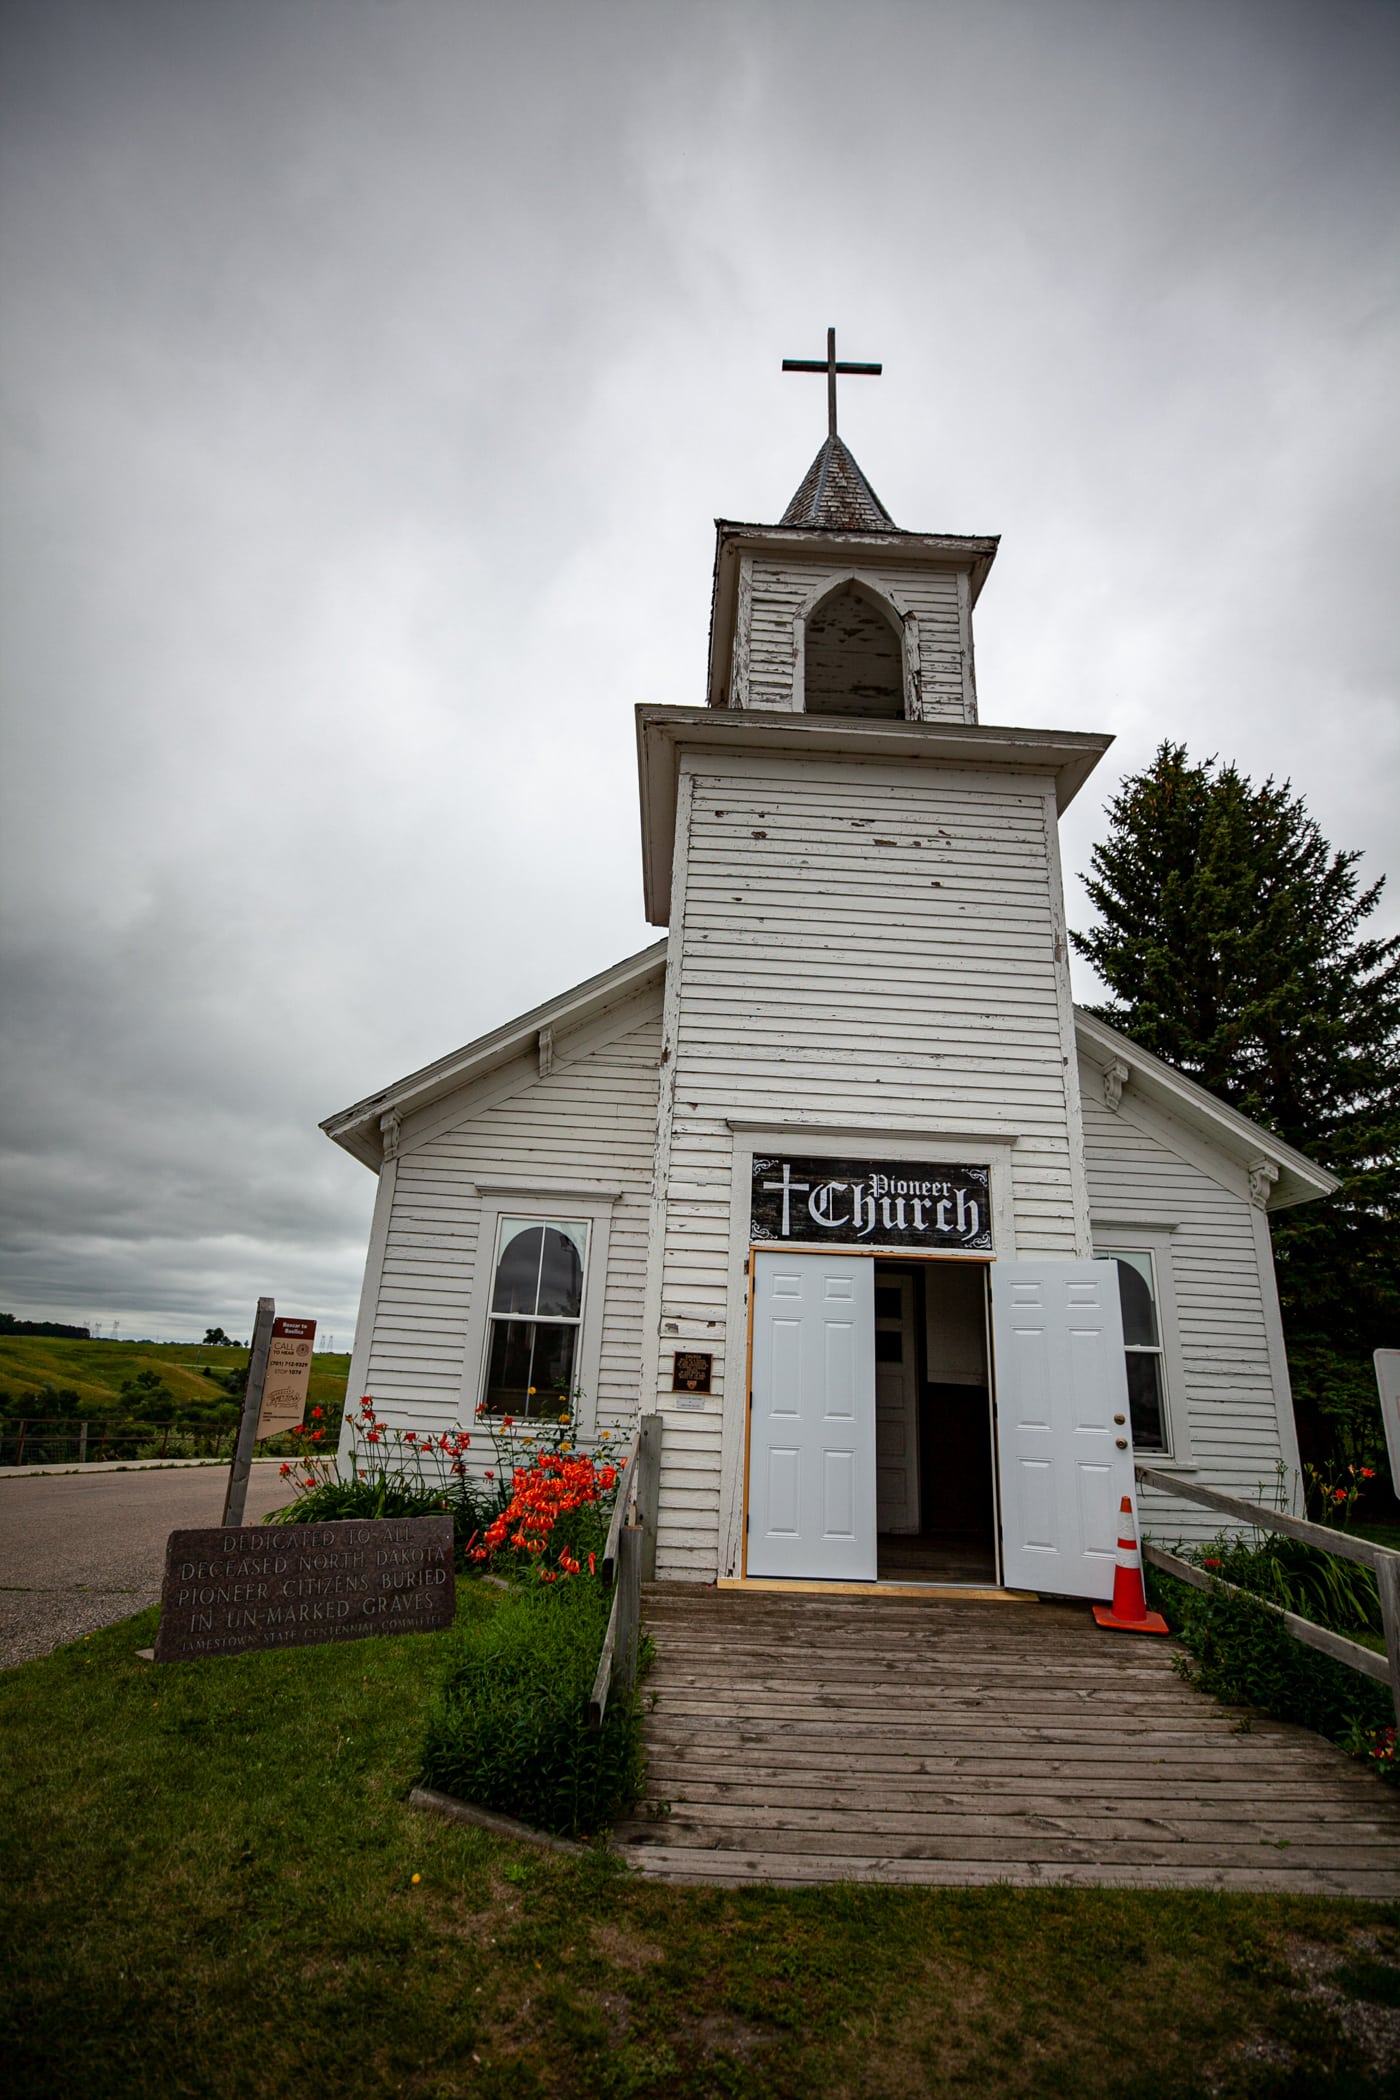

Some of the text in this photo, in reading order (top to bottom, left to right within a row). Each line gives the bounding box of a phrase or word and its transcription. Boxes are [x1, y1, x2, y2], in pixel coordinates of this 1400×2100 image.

[868, 1173, 952, 1198] Pioneer
[808, 1181, 979, 1241] Church
[274, 1342, 294, 1350] CALL
[223, 1526, 414, 1552] DEDICATED TO ALL
[181, 1546, 445, 1581] DECEASED NORTH DAKOTA
[178, 1568, 446, 1606] PIONEER CITIZENS BURIED
[190, 1592, 434, 1633] IN UN-MARKED GRAVES
[182, 1615, 443, 1652] JAMESTOWN STATE CENTENNIAL COMMITTEE
